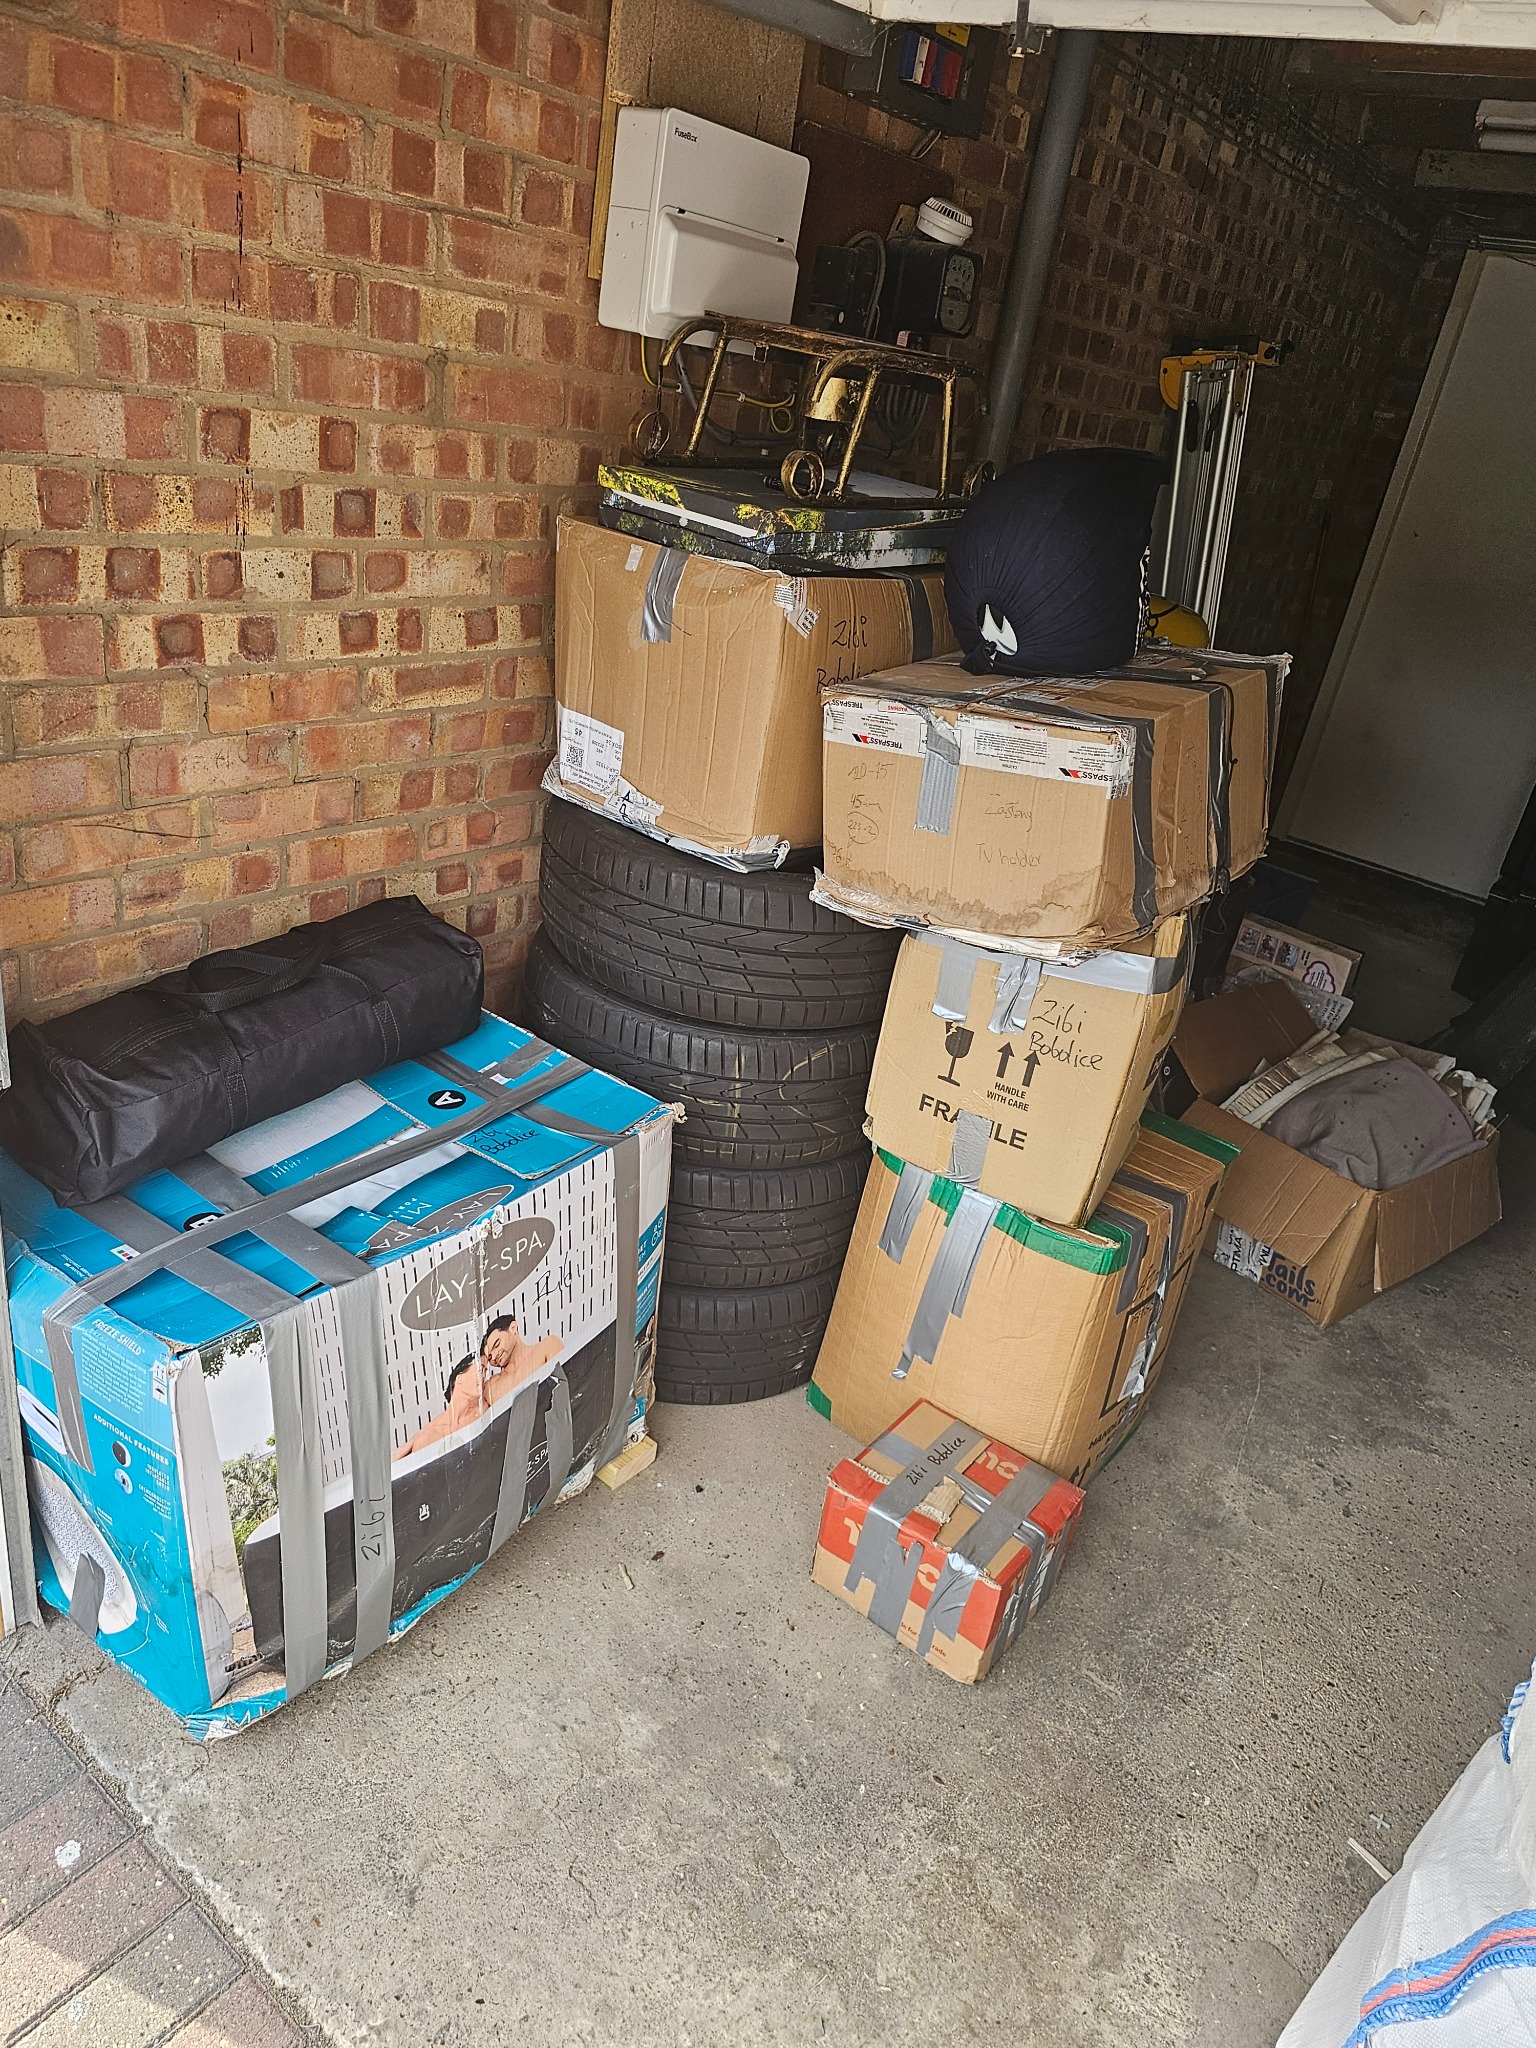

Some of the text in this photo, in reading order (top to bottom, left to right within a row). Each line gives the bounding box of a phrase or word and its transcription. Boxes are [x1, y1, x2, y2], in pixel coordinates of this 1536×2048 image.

[674, 127, 698, 143] FuseBox
[831, 699, 863, 709] TRESPASS
[869, 737, 903, 749] TRESPASS
[1082, 771, 1113, 782] ESPASS
[994, 1082, 1027, 1099] HANDLE
[987, 1090, 1030, 1112] WITH CARE
[919, 1093, 1028, 1151] FRAILE
[1231, 1237, 1242, 1271] PTIMA
[92, 1319, 118, 1339] FREEZE
[93, 1413, 169, 1466] ADDITIONAL FEATURES
[931, 1644, 947, 1657] rade
